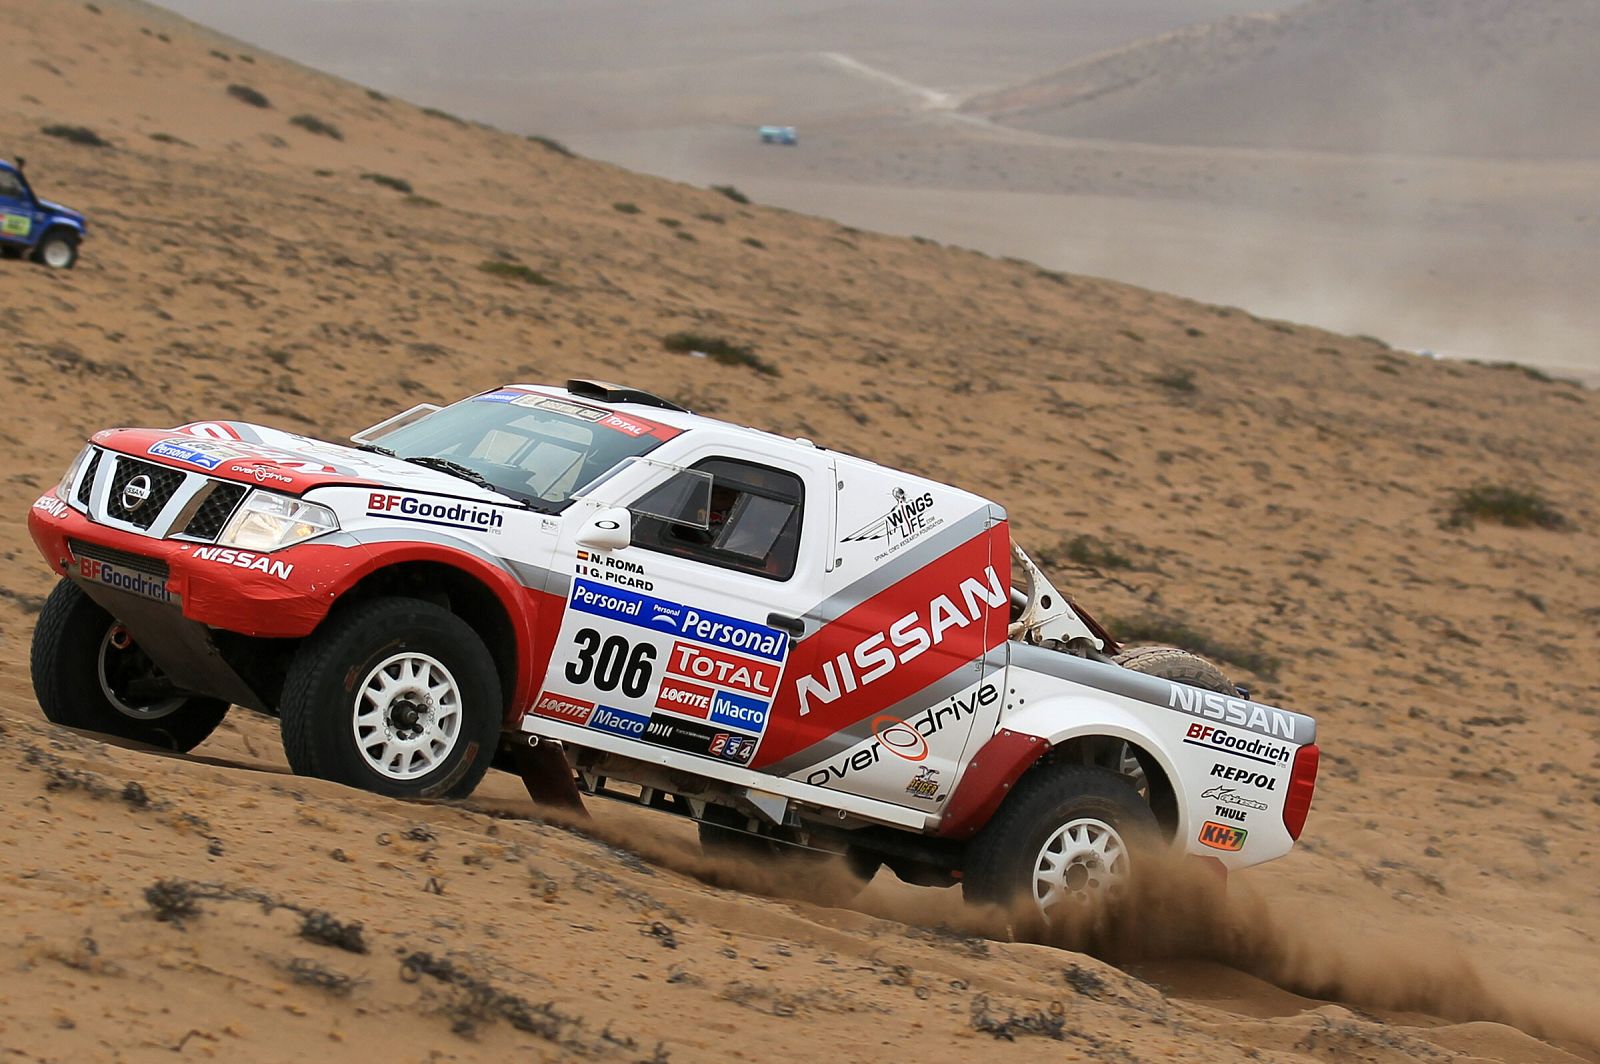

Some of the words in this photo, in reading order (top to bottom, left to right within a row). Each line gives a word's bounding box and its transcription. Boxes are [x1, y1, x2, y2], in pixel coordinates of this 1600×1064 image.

[606, 416, 642, 435] TOTAL
[152, 443, 195, 459] Personal
[367, 493, 504, 528] BFGoodrich
[887, 492, 934, 527] WINGS
[192, 546, 294, 580] NISSAN
[590, 554, 603, 565] N.
[606, 557, 645, 575] ROMA
[590, 568, 603, 579] G.
[605, 572, 654, 592] PICARD
[80, 559, 171, 602] BFGoodrich
[574, 586, 642, 616] Personal
[653, 604, 680, 617] Personal
[681, 610, 785, 656] Personal
[796, 565, 1008, 717] NISSAN
[565, 627, 657, 699] 306
[676, 645, 770, 693] TOTAL
[539, 698, 591, 718] LOCTITE
[594, 709, 644, 733] Macro
[660, 687, 710, 709] LOCTITE
[715, 698, 764, 724] Macro
[1169, 684, 1295, 740] NISSAN
[712, 739, 725, 753] 2
[726, 741, 740, 755] 3
[739, 745, 751, 759] 4
[1186, 723, 1290, 763] BFGoodrich
[1210, 763, 1277, 791] REPSOL
[1215, 805, 1247, 822] THULE
[1202, 824, 1244, 848] KH-7
